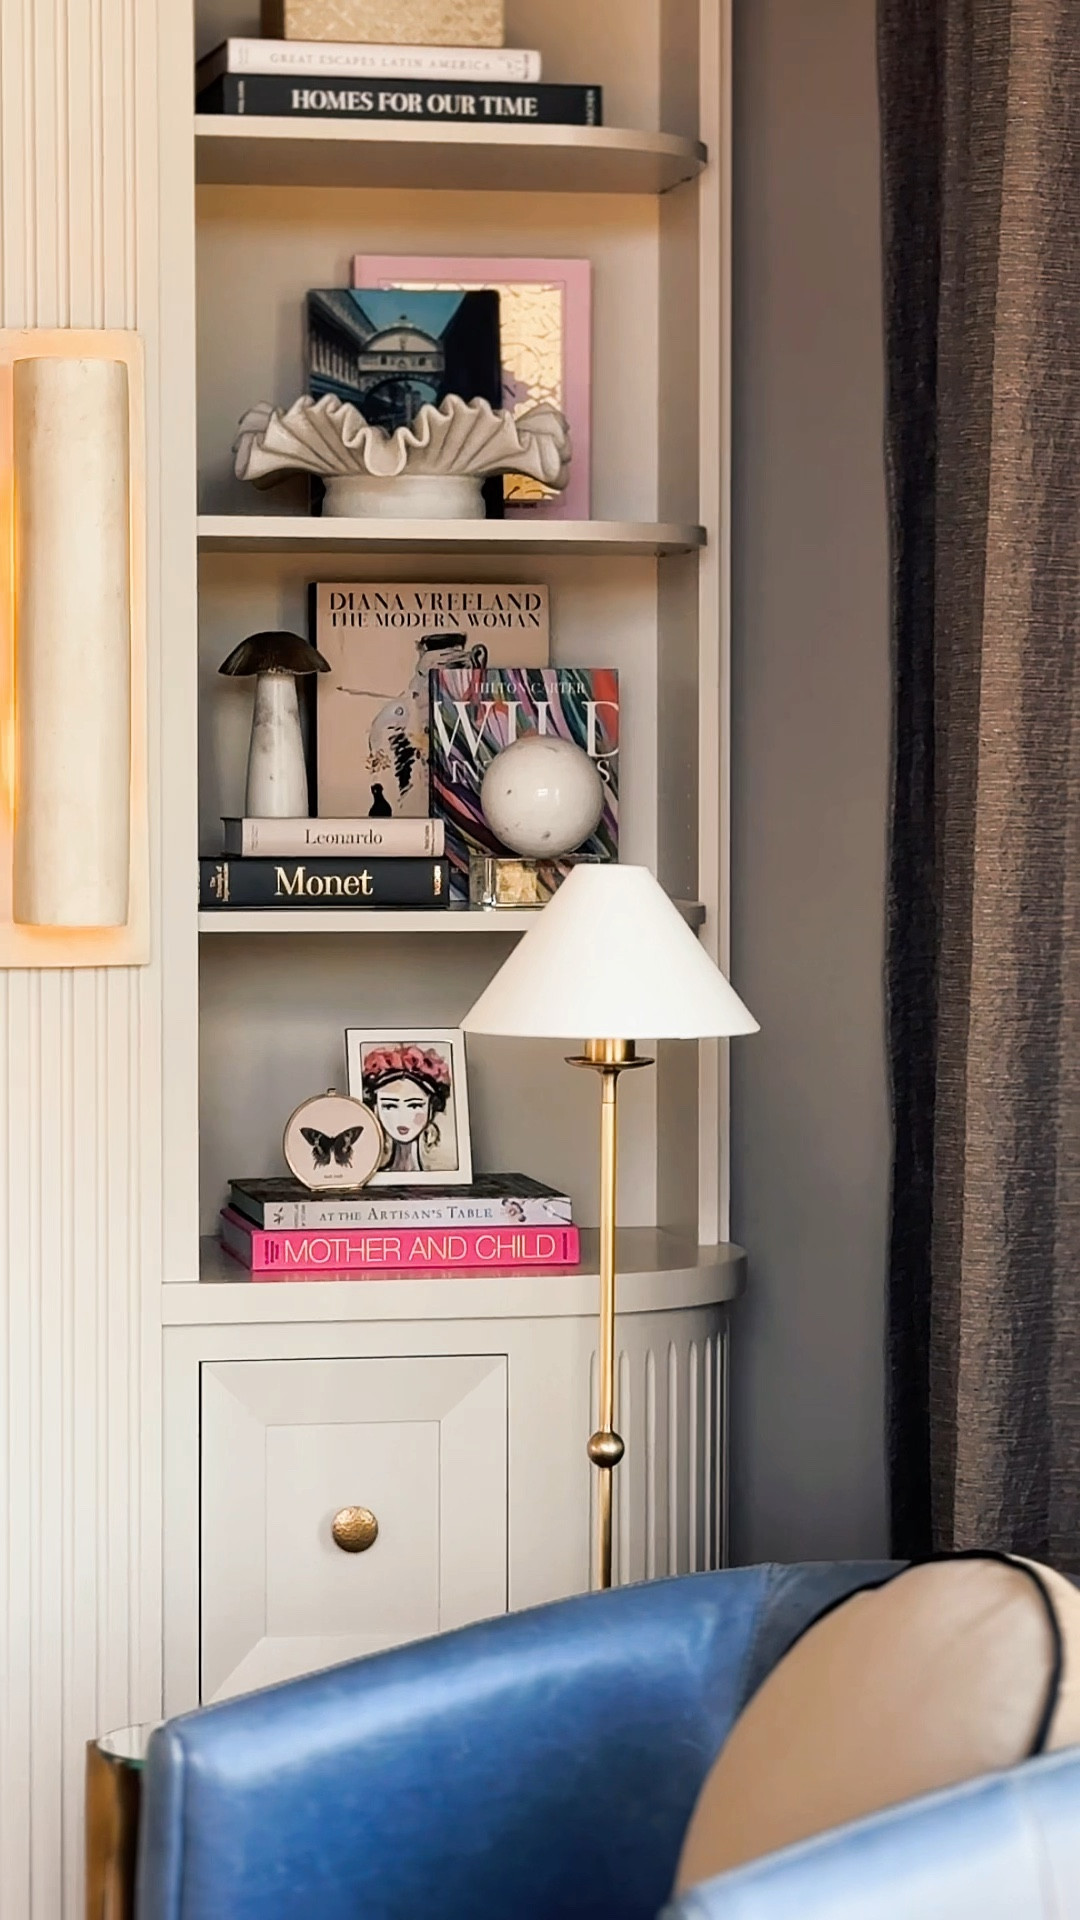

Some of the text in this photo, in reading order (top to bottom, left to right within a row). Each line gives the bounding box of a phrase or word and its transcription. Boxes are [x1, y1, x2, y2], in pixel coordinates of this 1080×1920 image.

[381, 57, 423, 69] LATIN
[291, 88, 539, 117] HOMES FOR OUR TIME
[330, 592, 541, 611] DIANA VREELAND
[329, 612, 541, 628] THE MODERN WOMAN
[474, 681, 586, 694] HILTON CARTER
[305, 829, 383, 845] Leonardo
[274, 866, 374, 896] Monet
[319, 1213, 335, 1222] AT
[338, 1211, 362, 1222] THE
[446, 1206, 493, 1219] TABLE
[284, 1237, 401, 1264] MOTHER
[408, 1236, 467, 1261] AND
[475, 1234, 556, 1260] CHILD
